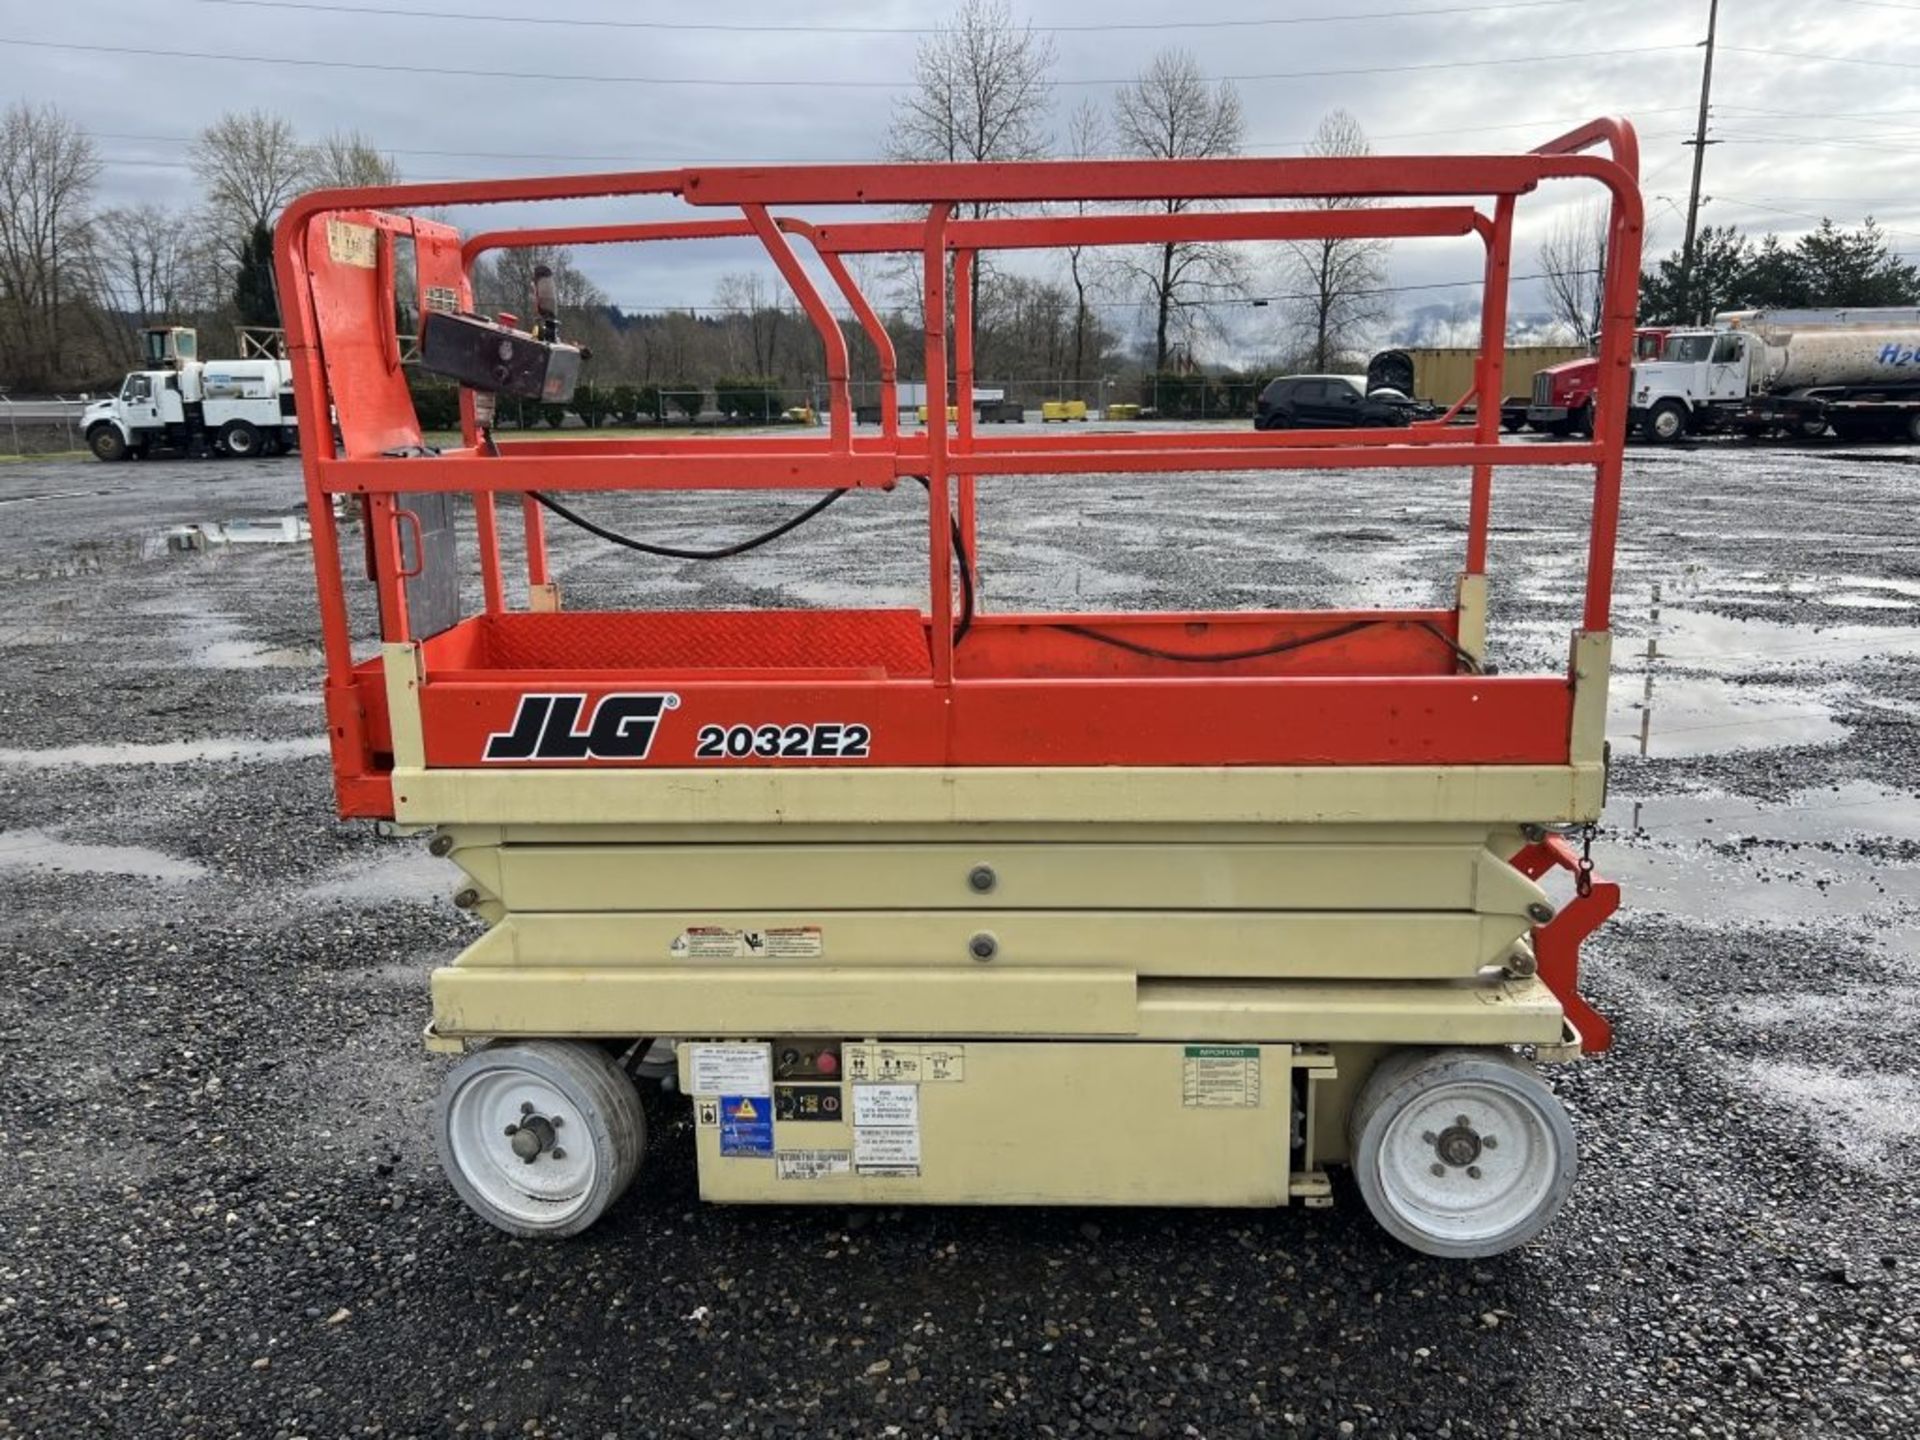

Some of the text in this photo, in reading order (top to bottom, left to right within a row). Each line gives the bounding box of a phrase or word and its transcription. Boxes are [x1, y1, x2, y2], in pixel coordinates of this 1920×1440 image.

[482, 693, 669, 761] JLG
[695, 723, 871, 758] 2032E2
[1199, 1048, 1245, 1057] IMPORTANT
